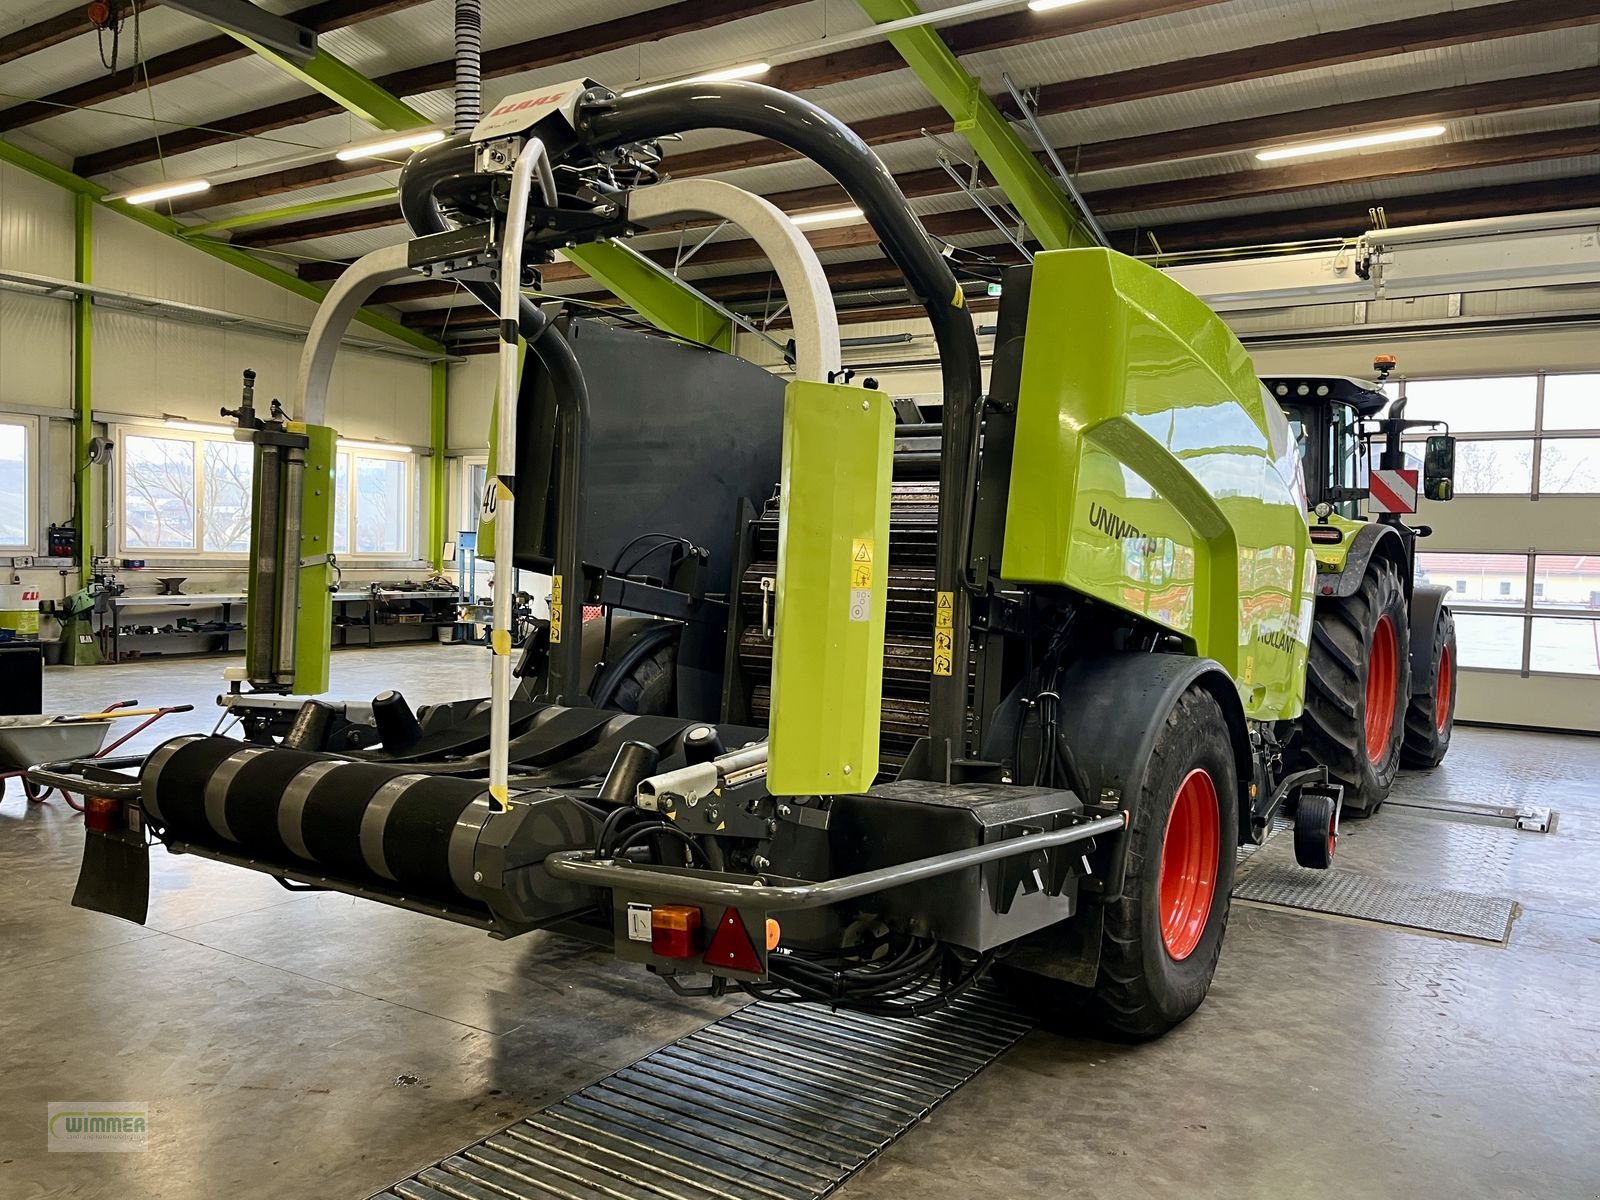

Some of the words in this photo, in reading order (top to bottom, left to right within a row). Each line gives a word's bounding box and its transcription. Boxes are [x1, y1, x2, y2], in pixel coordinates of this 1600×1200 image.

[491, 93, 565, 116] CLAAS
[483, 484, 496, 513] 40
[1089, 502, 1157, 557] UNIWRAP
